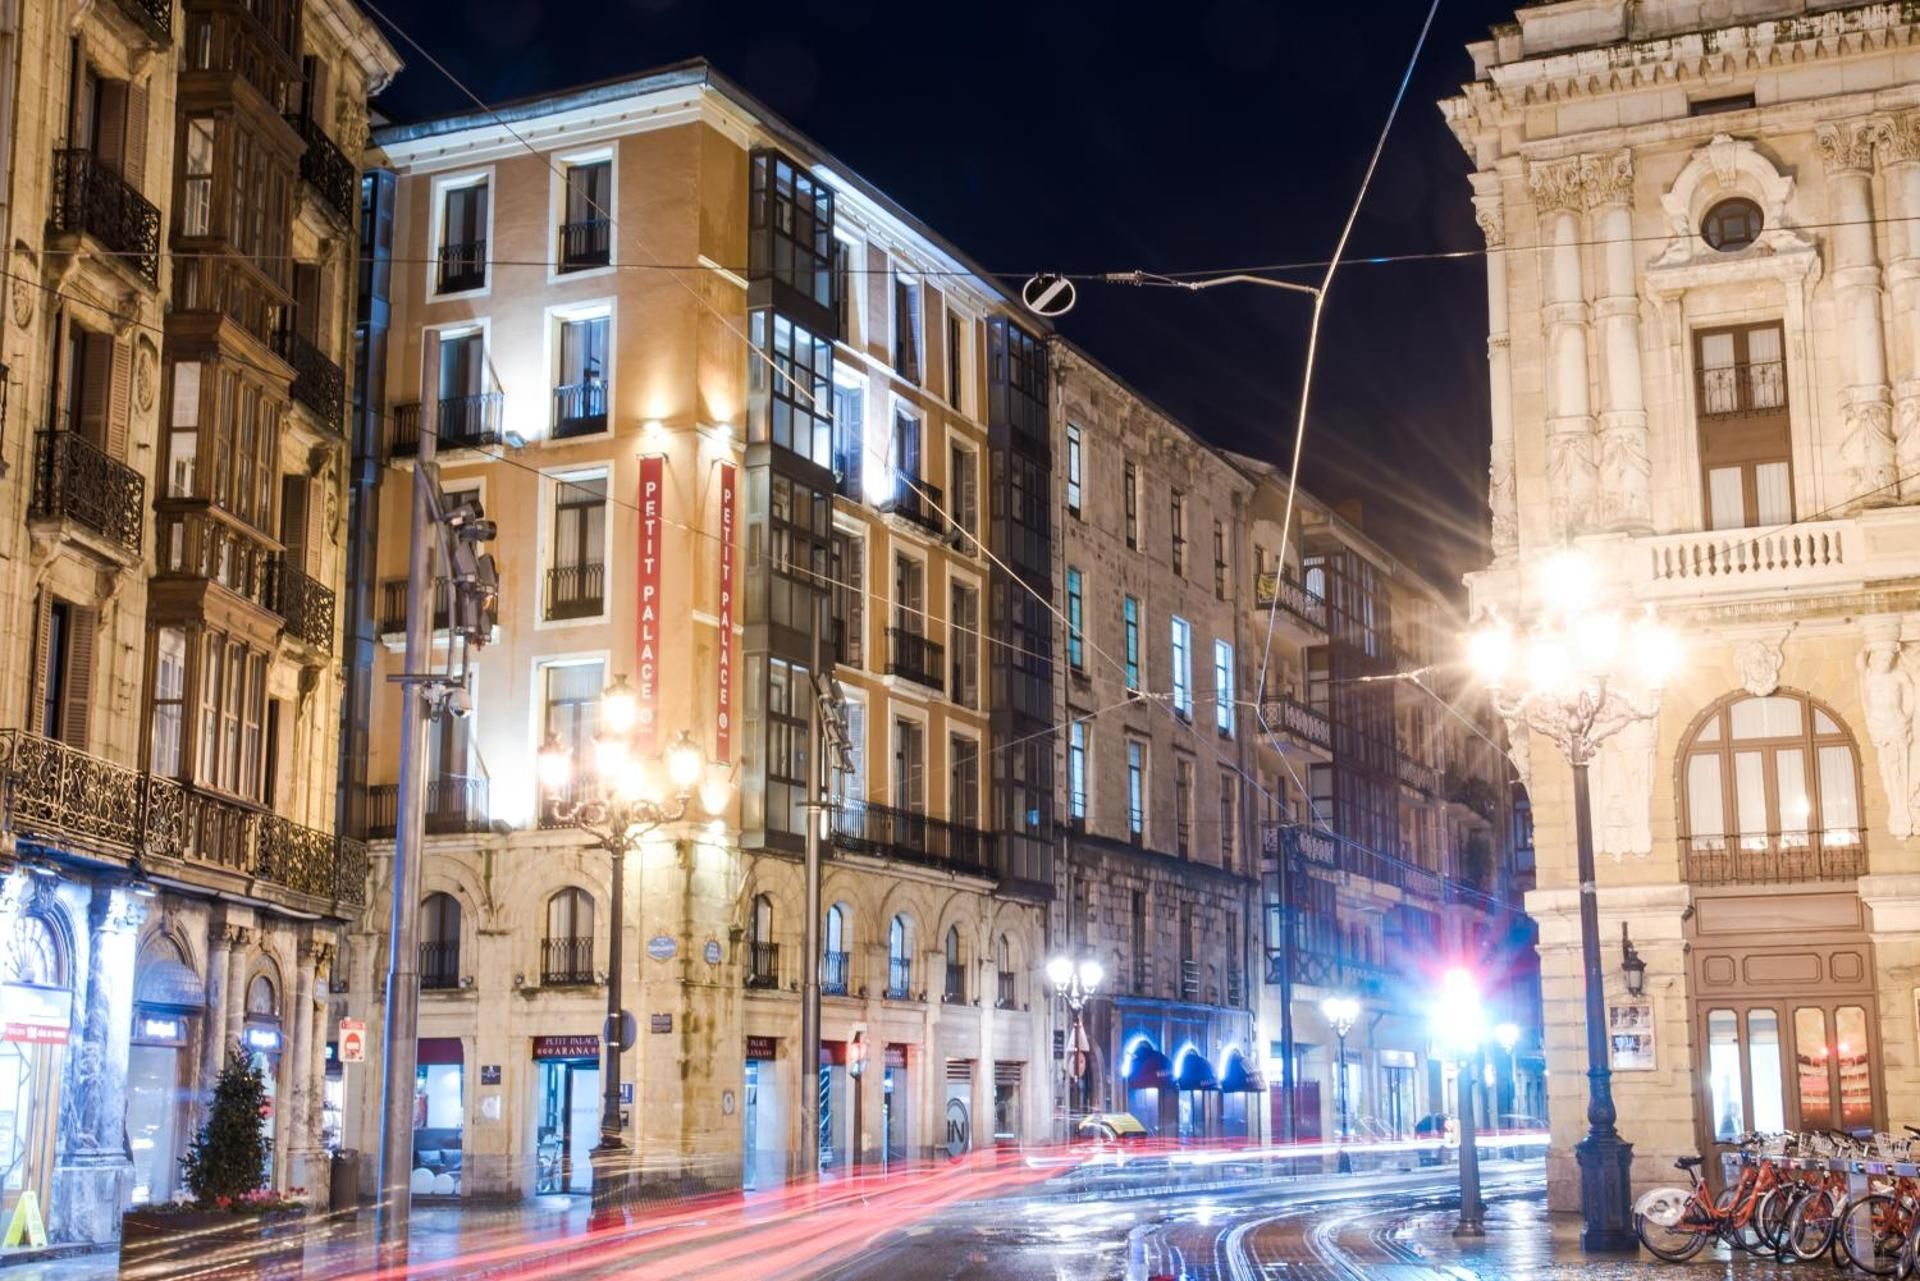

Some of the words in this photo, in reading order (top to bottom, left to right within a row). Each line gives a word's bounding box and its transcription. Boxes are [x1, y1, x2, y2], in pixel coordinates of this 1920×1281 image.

[644, 481, 657, 574] PETIT
[722, 489, 732, 581] PETIT
[641, 585, 655, 699] PALACE
[720, 592, 729, 705] PALACE
[554, 1047, 590, 1056] ARANA
